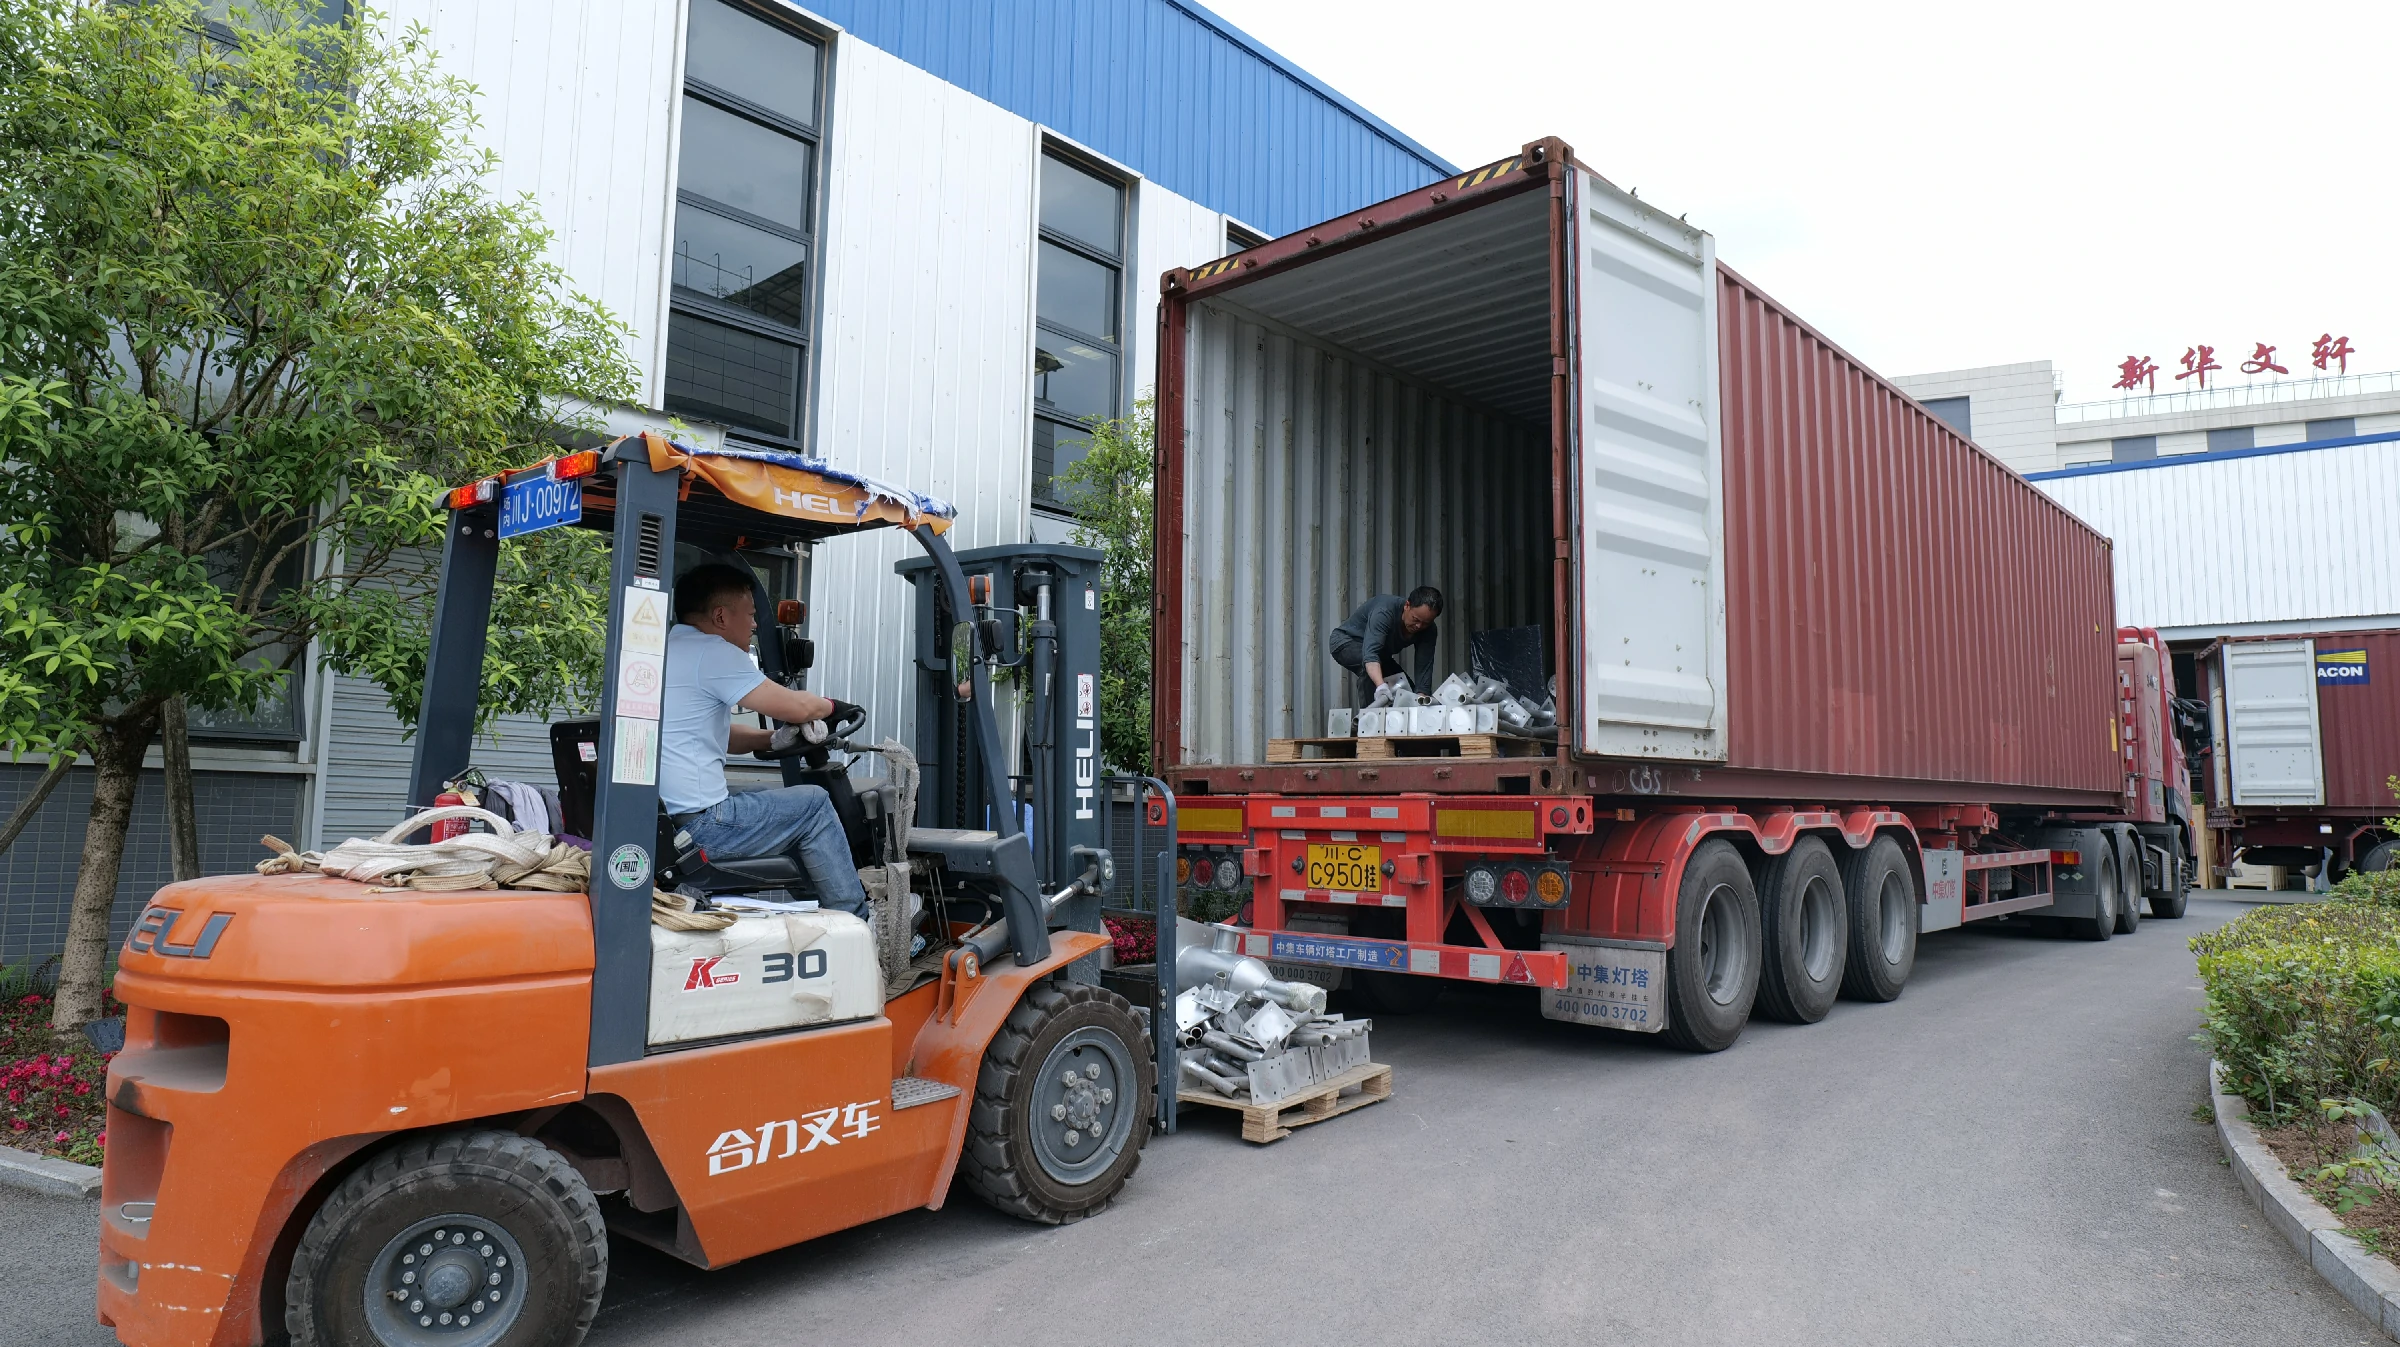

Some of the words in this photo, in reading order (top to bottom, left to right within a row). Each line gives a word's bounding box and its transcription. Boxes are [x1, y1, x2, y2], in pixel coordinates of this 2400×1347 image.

[2112, 333, 2355, 394] 新华文轩
[1076, 719, 1093, 819] HELI
[1311, 862, 1376, 888] C950挂
[762, 949, 827, 984] 30
[1276, 941, 1378, 962] 中集车辆灯塔工厂制造
[684, 955, 725, 991] K
[1287, 968, 1305, 980] 000
[1307, 970, 1332, 983] 3702
[1577, 964, 1649, 988] 中集灯塔
[1555, 1000, 1579, 1013] 400
[1583, 1003, 1608, 1018] 000
[1612, 1006, 1647, 1022] 3702
[706, 1100, 881, 1177] 合力叉车
